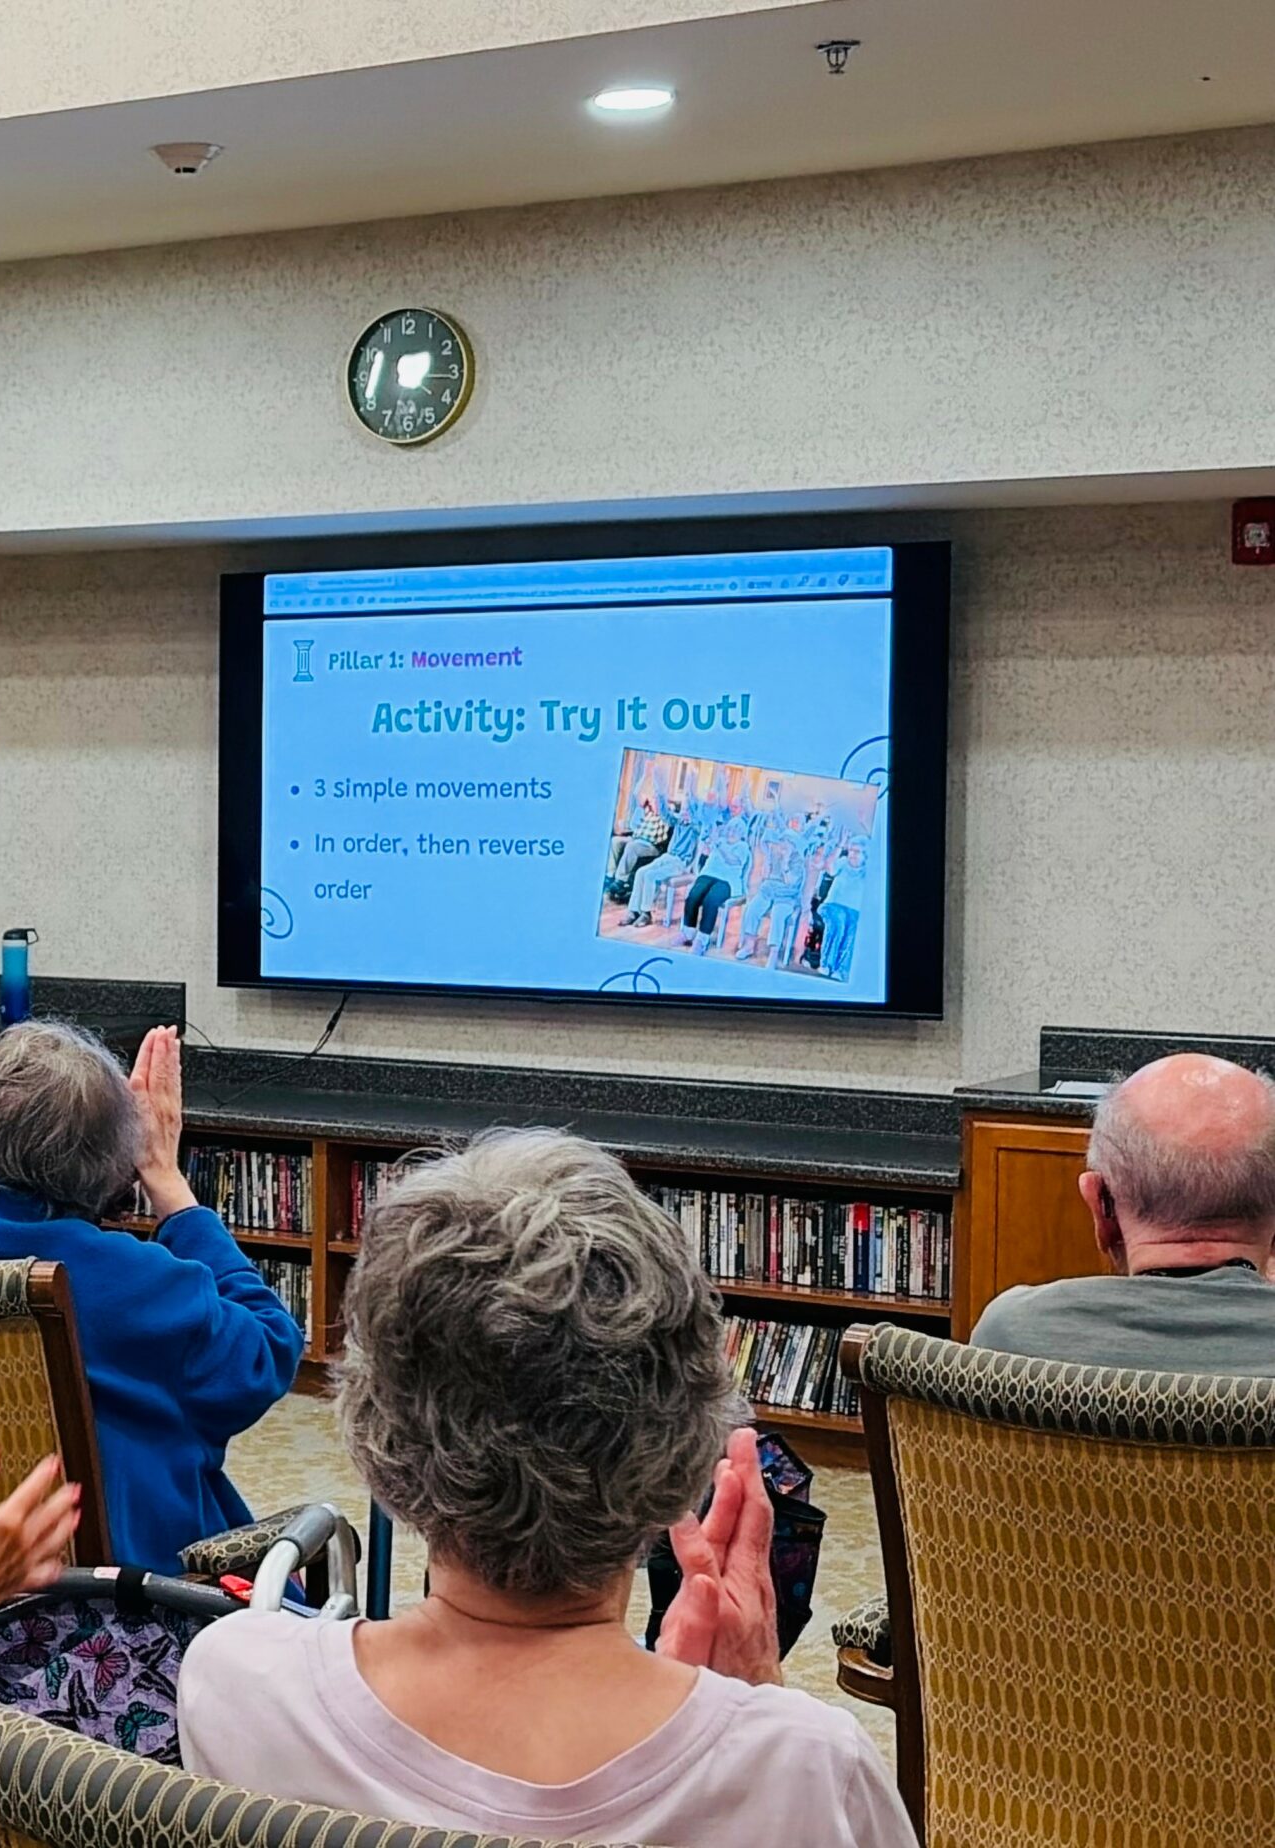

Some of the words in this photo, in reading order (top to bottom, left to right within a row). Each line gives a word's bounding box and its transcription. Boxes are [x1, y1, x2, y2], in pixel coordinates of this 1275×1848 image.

[401, 317, 416, 335] 12
[383, 327, 392, 344] 11
[441, 340, 452, 355] 2
[359, 371, 369, 388] 9
[448, 364, 459, 380] 3
[366, 394, 377, 411] 8
[441, 388, 452, 404] 4
[382, 409, 392, 426] 7
[402, 416, 414, 432] 6
[424, 407, 435, 424] 5
[328, 650, 383, 670] Pillar
[389, 650, 405, 669] 1:
[411, 646, 523, 668] Movement
[372, 698, 525, 743] Activity:
[539, 700, 601, 743] Try
[617, 696, 647, 732] It
[663, 694, 751, 732] Out!
[314, 778, 326, 798] 3
[333, 777, 408, 803] simple
[415, 777, 552, 800] movements
[314, 833, 335, 853] In
[343, 832, 409, 857] order,
[416, 833, 470, 855] then
[478, 838, 565, 857] reverse
[314, 879, 372, 900] order
